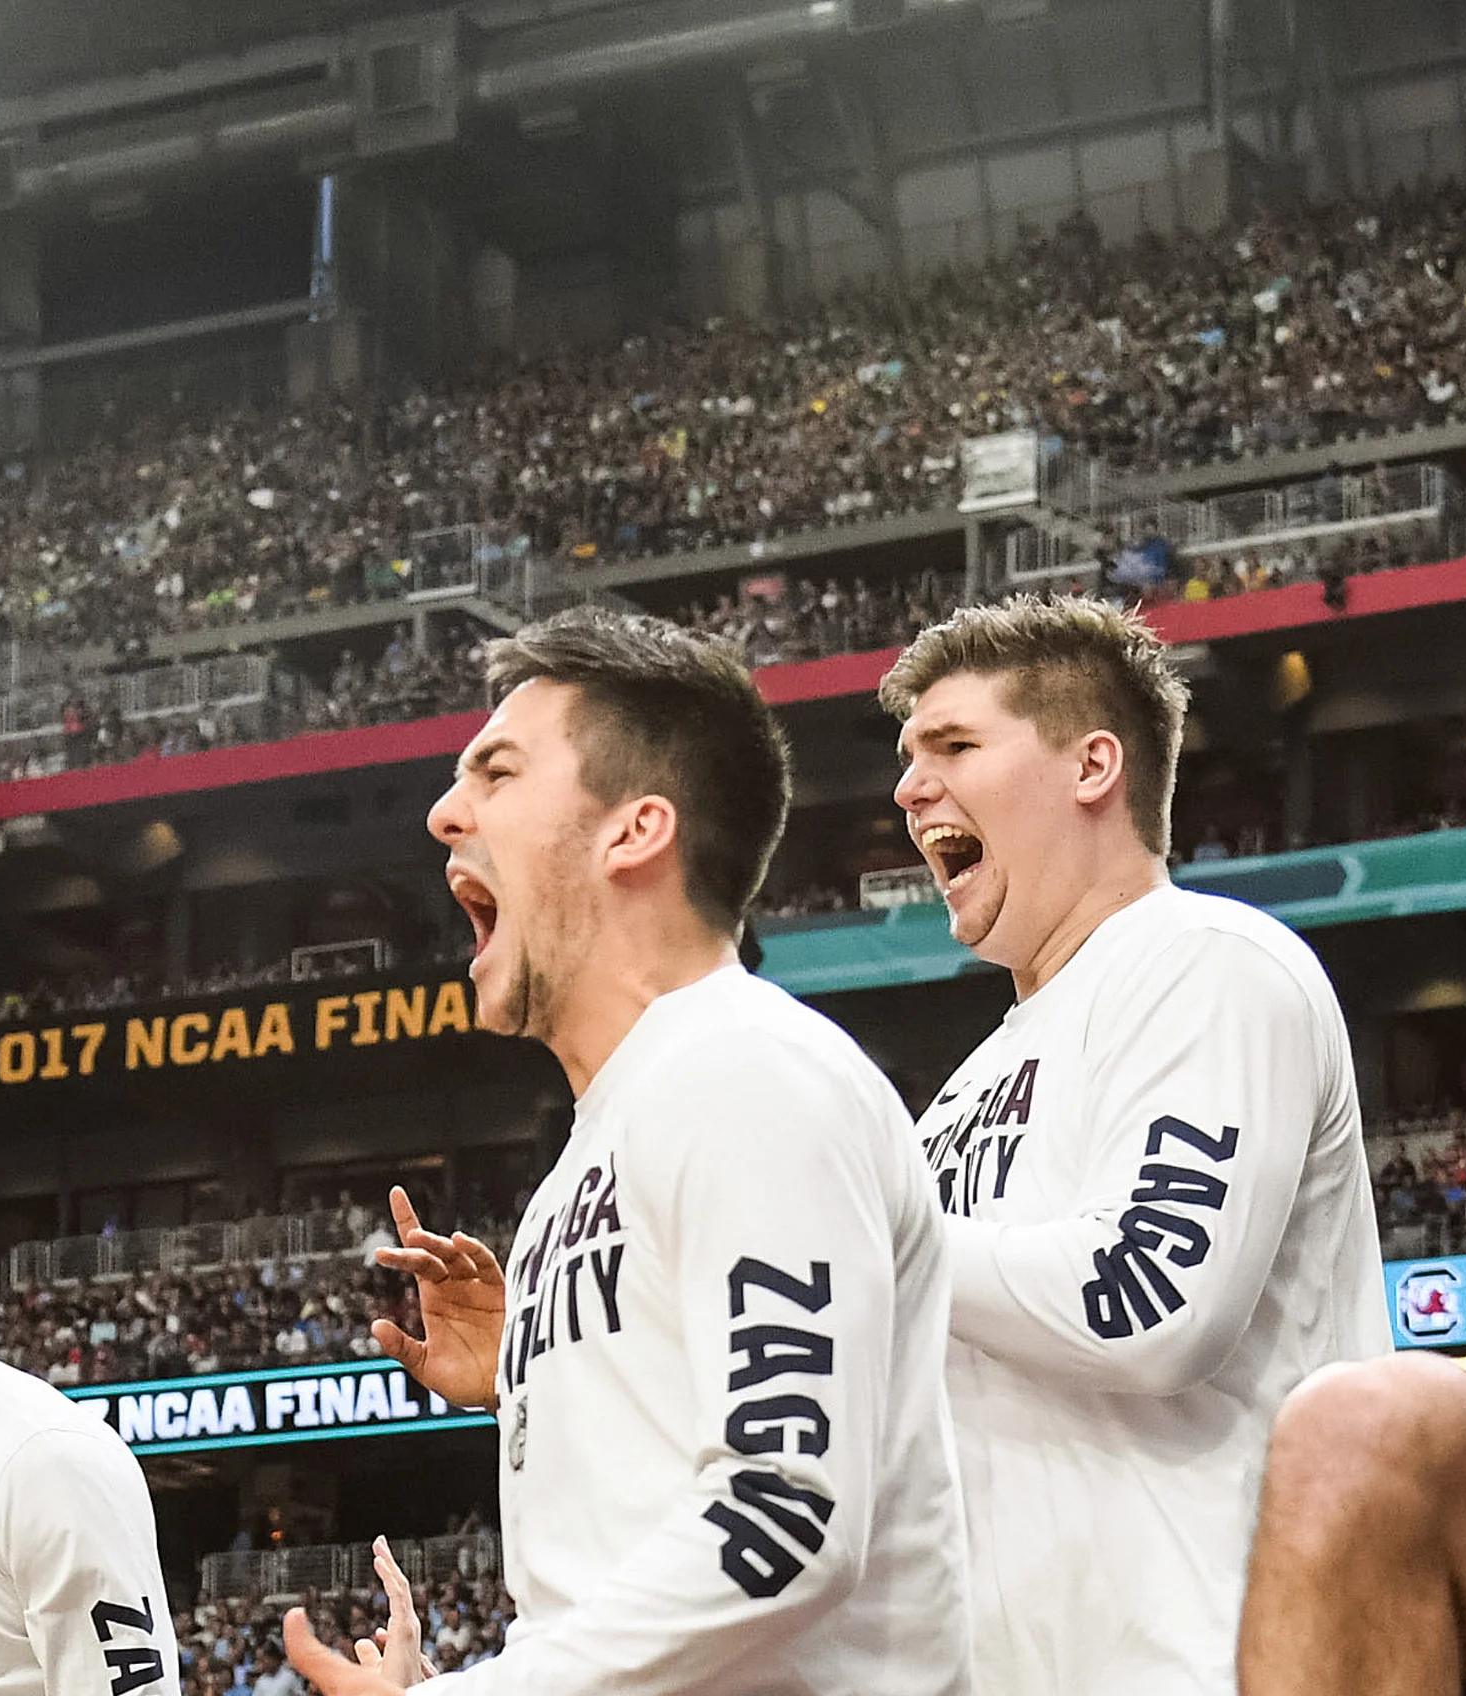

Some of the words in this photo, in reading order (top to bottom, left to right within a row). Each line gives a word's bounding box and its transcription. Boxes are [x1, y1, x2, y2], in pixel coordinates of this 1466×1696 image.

[125, 1003, 294, 1071] NCAA
[315, 980, 483, 1050] FINA
[118, 1386, 257, 1443] NCAA
[265, 1371, 419, 1429] FINAL
